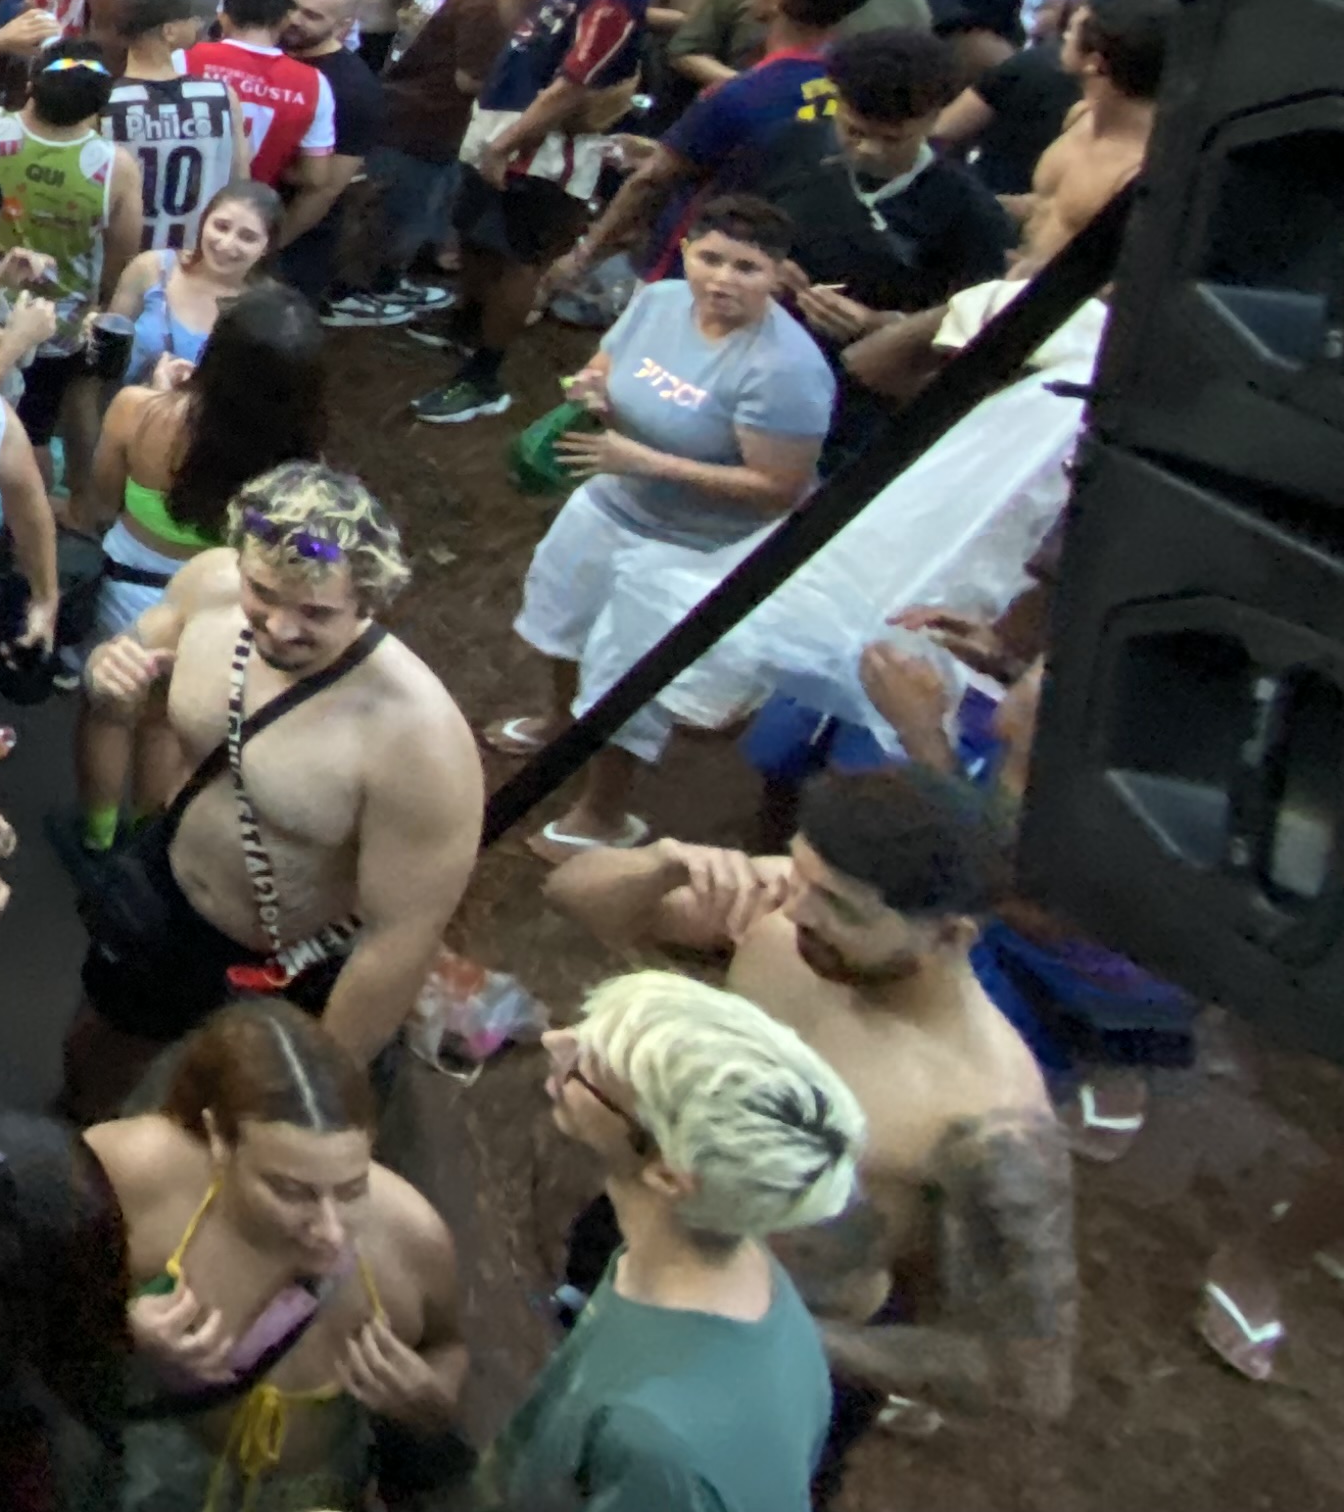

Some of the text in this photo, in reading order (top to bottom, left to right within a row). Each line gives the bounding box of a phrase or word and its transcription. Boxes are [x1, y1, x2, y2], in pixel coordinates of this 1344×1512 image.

[239, 78, 305, 105] GUSTA
[125, 112, 213, 139] Philco
[25, 162, 66, 188] QUI
[137, 145, 204, 218] 10
